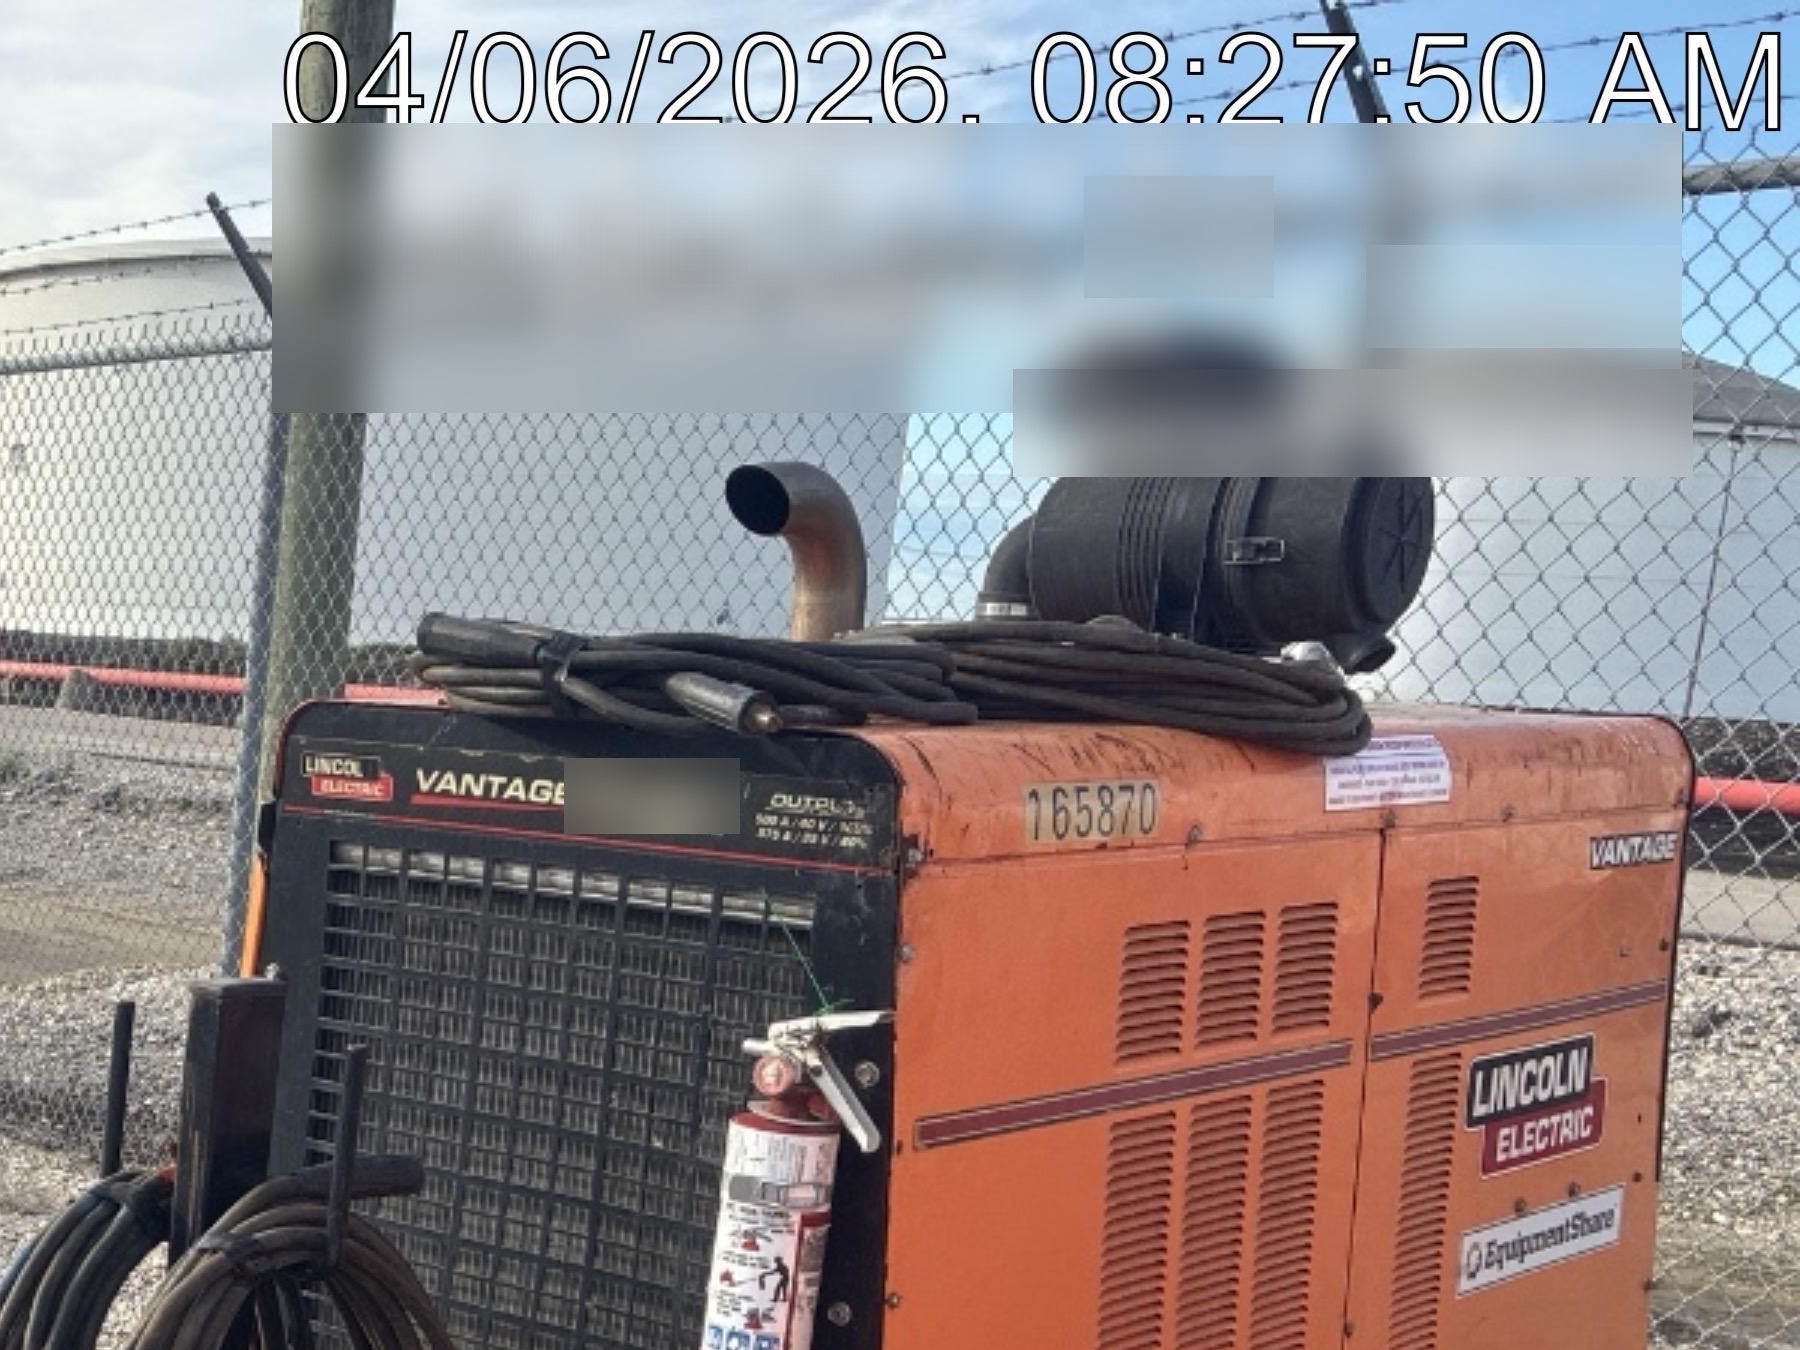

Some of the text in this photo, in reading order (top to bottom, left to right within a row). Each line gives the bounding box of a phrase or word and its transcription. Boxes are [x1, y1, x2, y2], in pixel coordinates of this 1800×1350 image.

[304, 755, 368, 778] LINCOL
[1028, 782, 1156, 841] 165870
[1591, 833, 1677, 868] VANTAGE
[1472, 1047, 1588, 1118] LINCOLN
[1496, 1105, 1594, 1162] ELECTRIC
[1484, 1207, 1616, 1270] EquipmentShare
